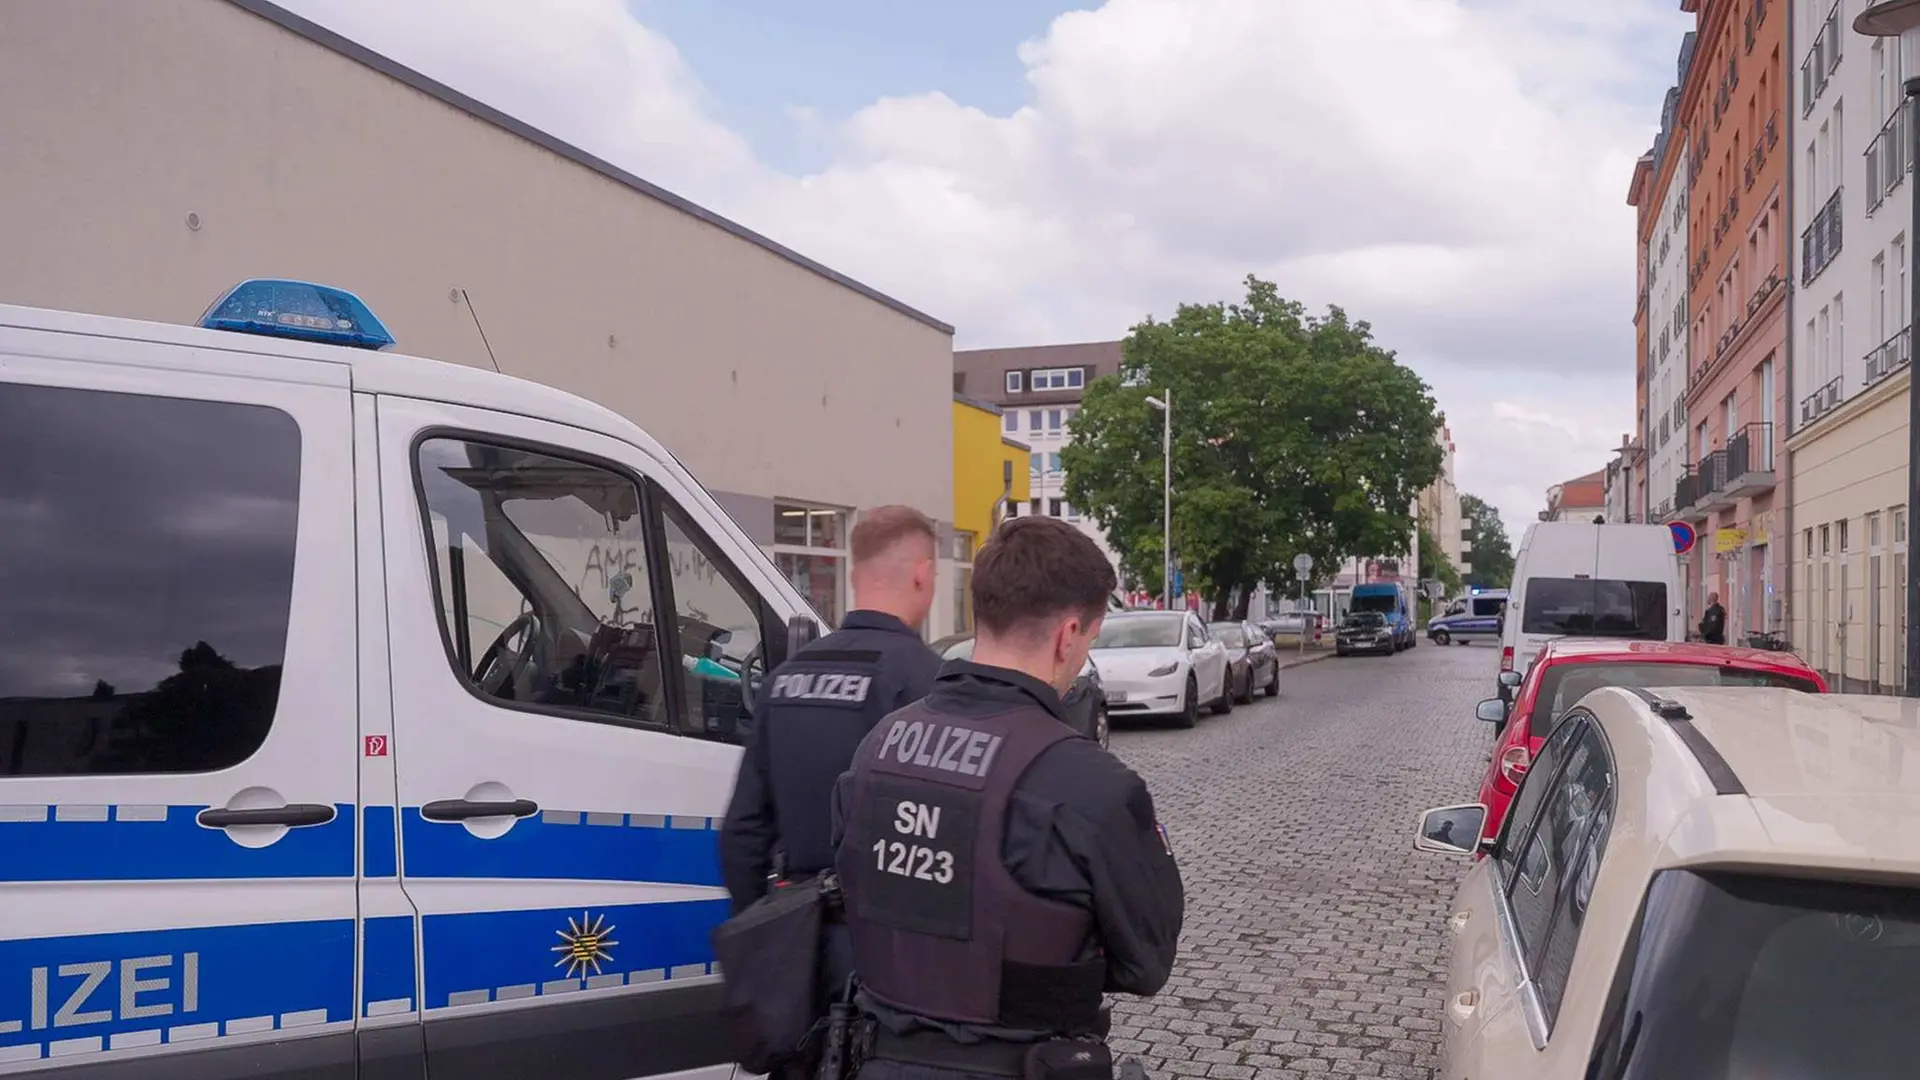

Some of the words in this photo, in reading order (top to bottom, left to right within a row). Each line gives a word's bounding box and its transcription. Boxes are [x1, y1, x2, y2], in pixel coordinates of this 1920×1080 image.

[770, 673, 872, 702] POLIZEI
[878, 720, 1002, 777] POLIZEI
[894, 801, 941, 839] SN
[873, 838, 954, 884] 12/23
